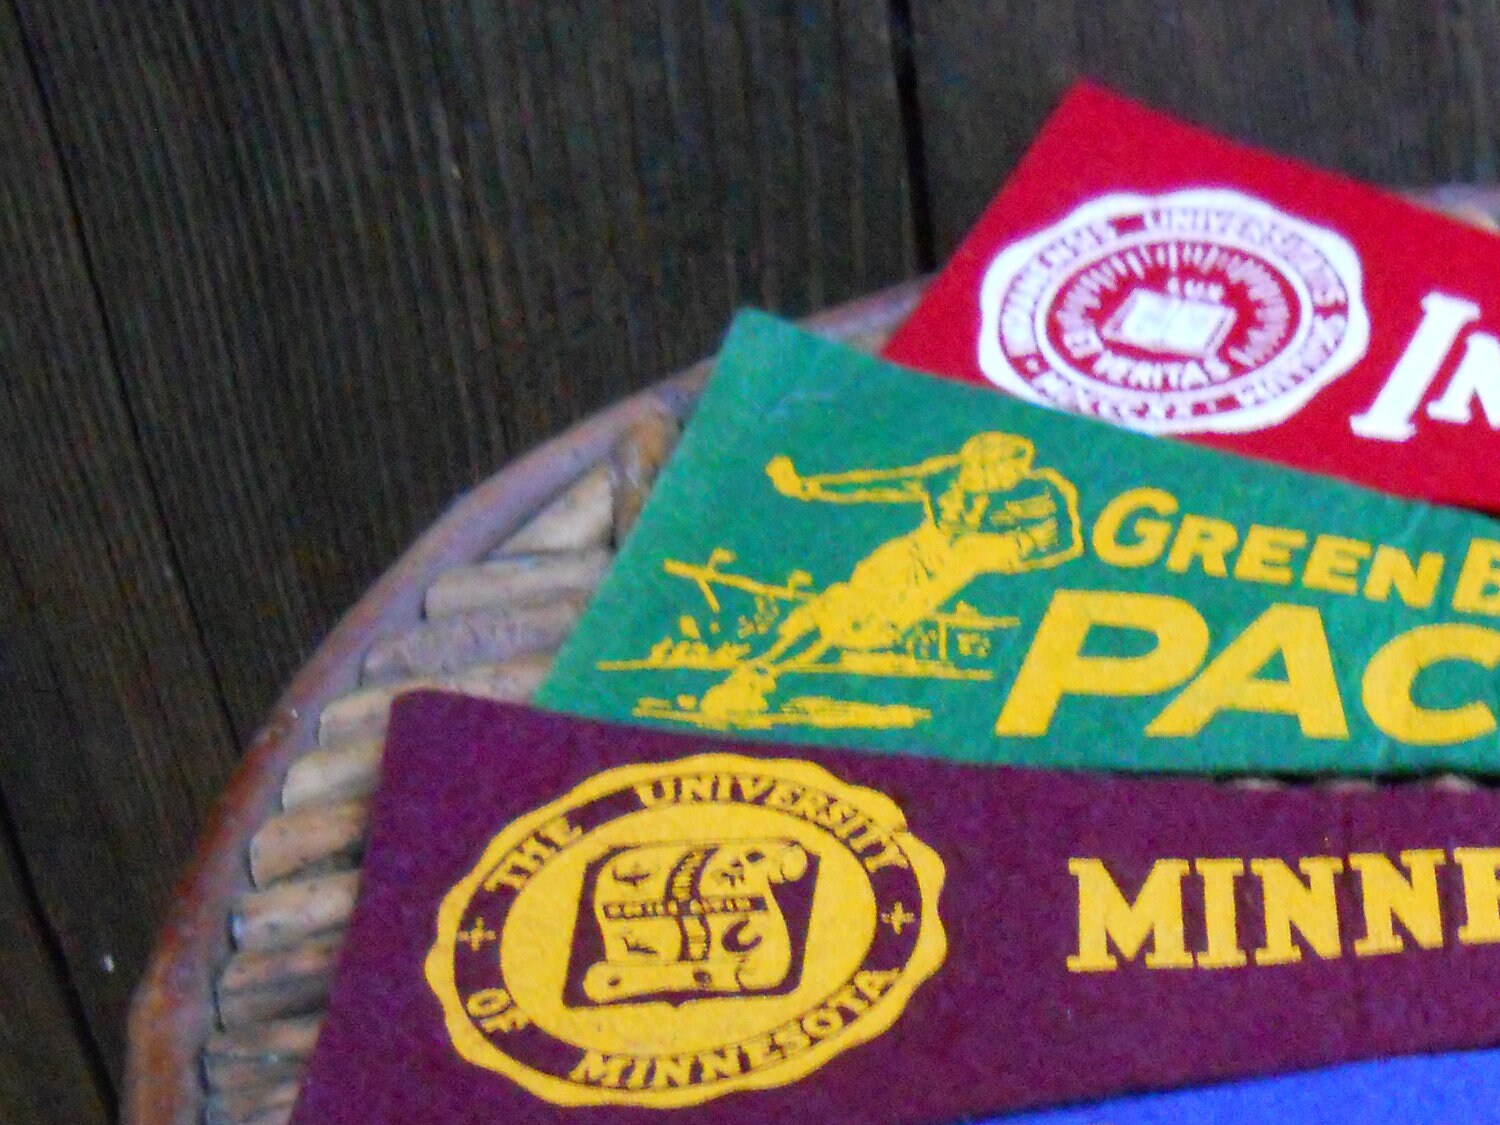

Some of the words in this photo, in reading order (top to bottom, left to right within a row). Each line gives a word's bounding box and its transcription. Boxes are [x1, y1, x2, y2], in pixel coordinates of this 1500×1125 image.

[1091, 487, 1443, 608] GREEN
[484, 816, 583, 893] THE
[634, 773, 908, 874] UNIVERSITY
[466, 988, 533, 1035] OF
[570, 968, 902, 1090] MINNESOTA
